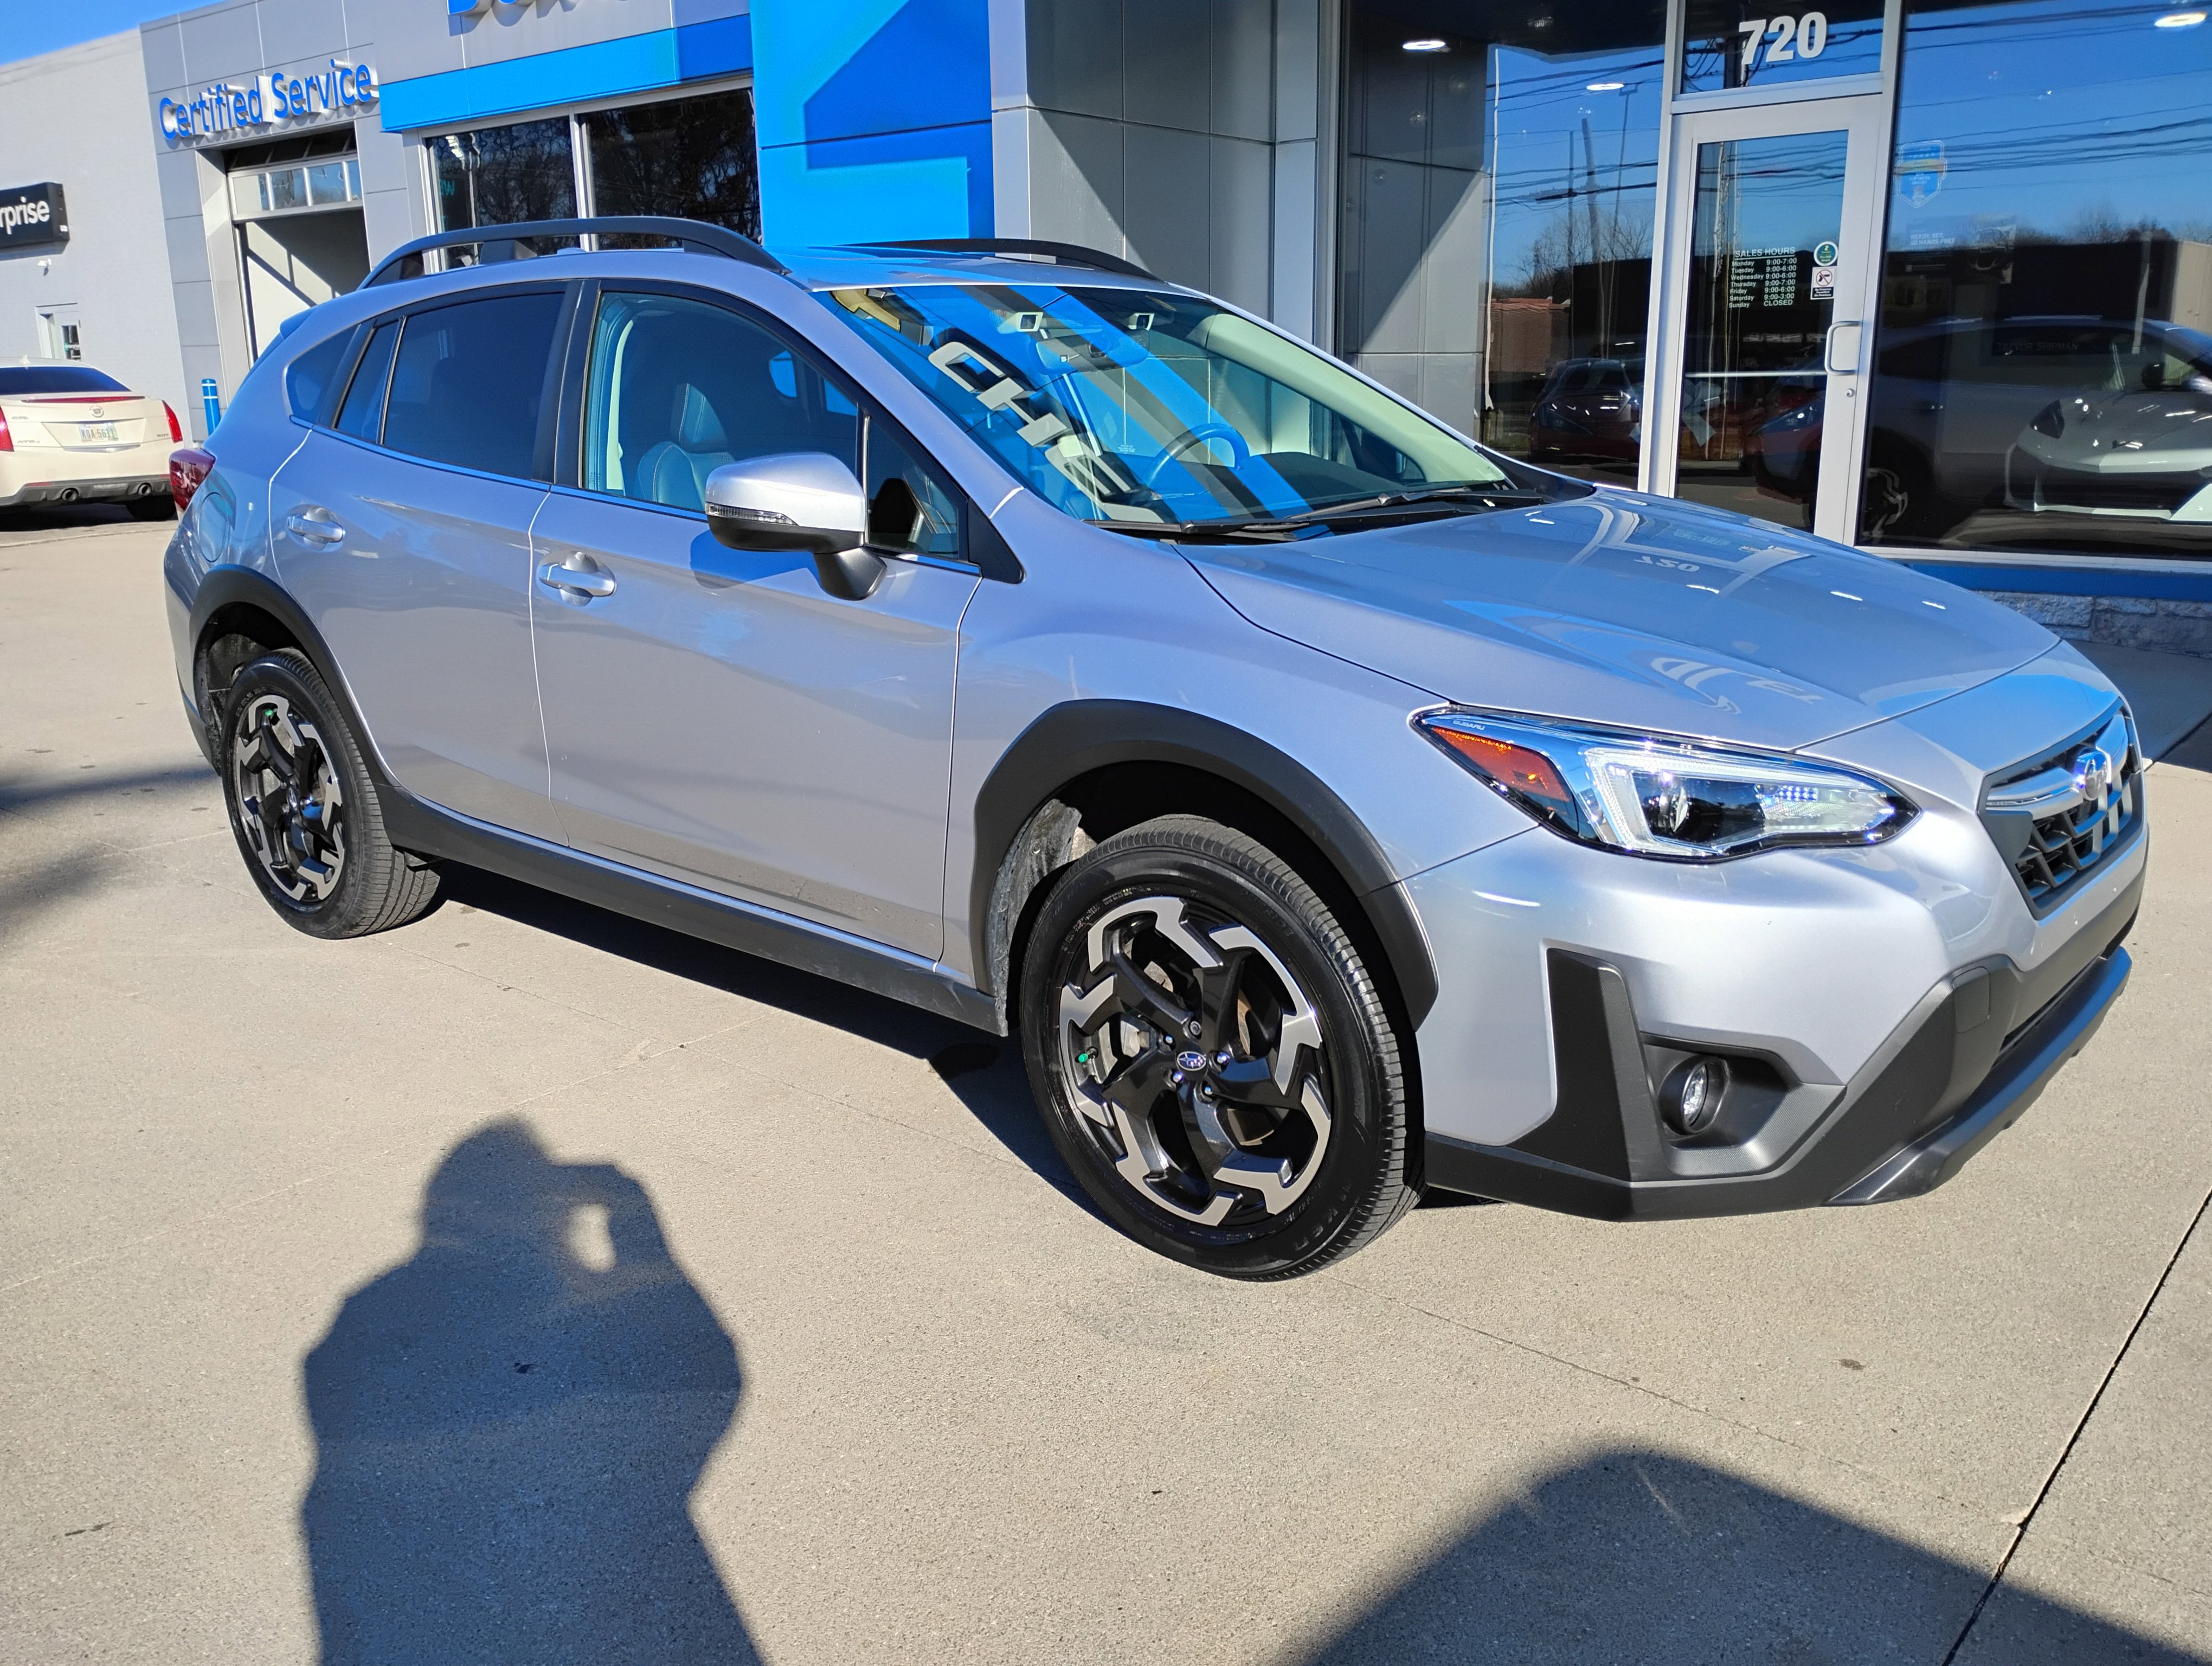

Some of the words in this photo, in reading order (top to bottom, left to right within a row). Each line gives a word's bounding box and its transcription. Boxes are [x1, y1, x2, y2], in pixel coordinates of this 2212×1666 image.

[1738, 12, 1827, 65] 720
[159, 76, 263, 140] Certified
[271, 59, 373, 119] Service
[1735, 249, 1763, 258] SALES
[1765, 247, 1796, 256] HOURS
[1453, 720, 1486, 731] SUBARU
